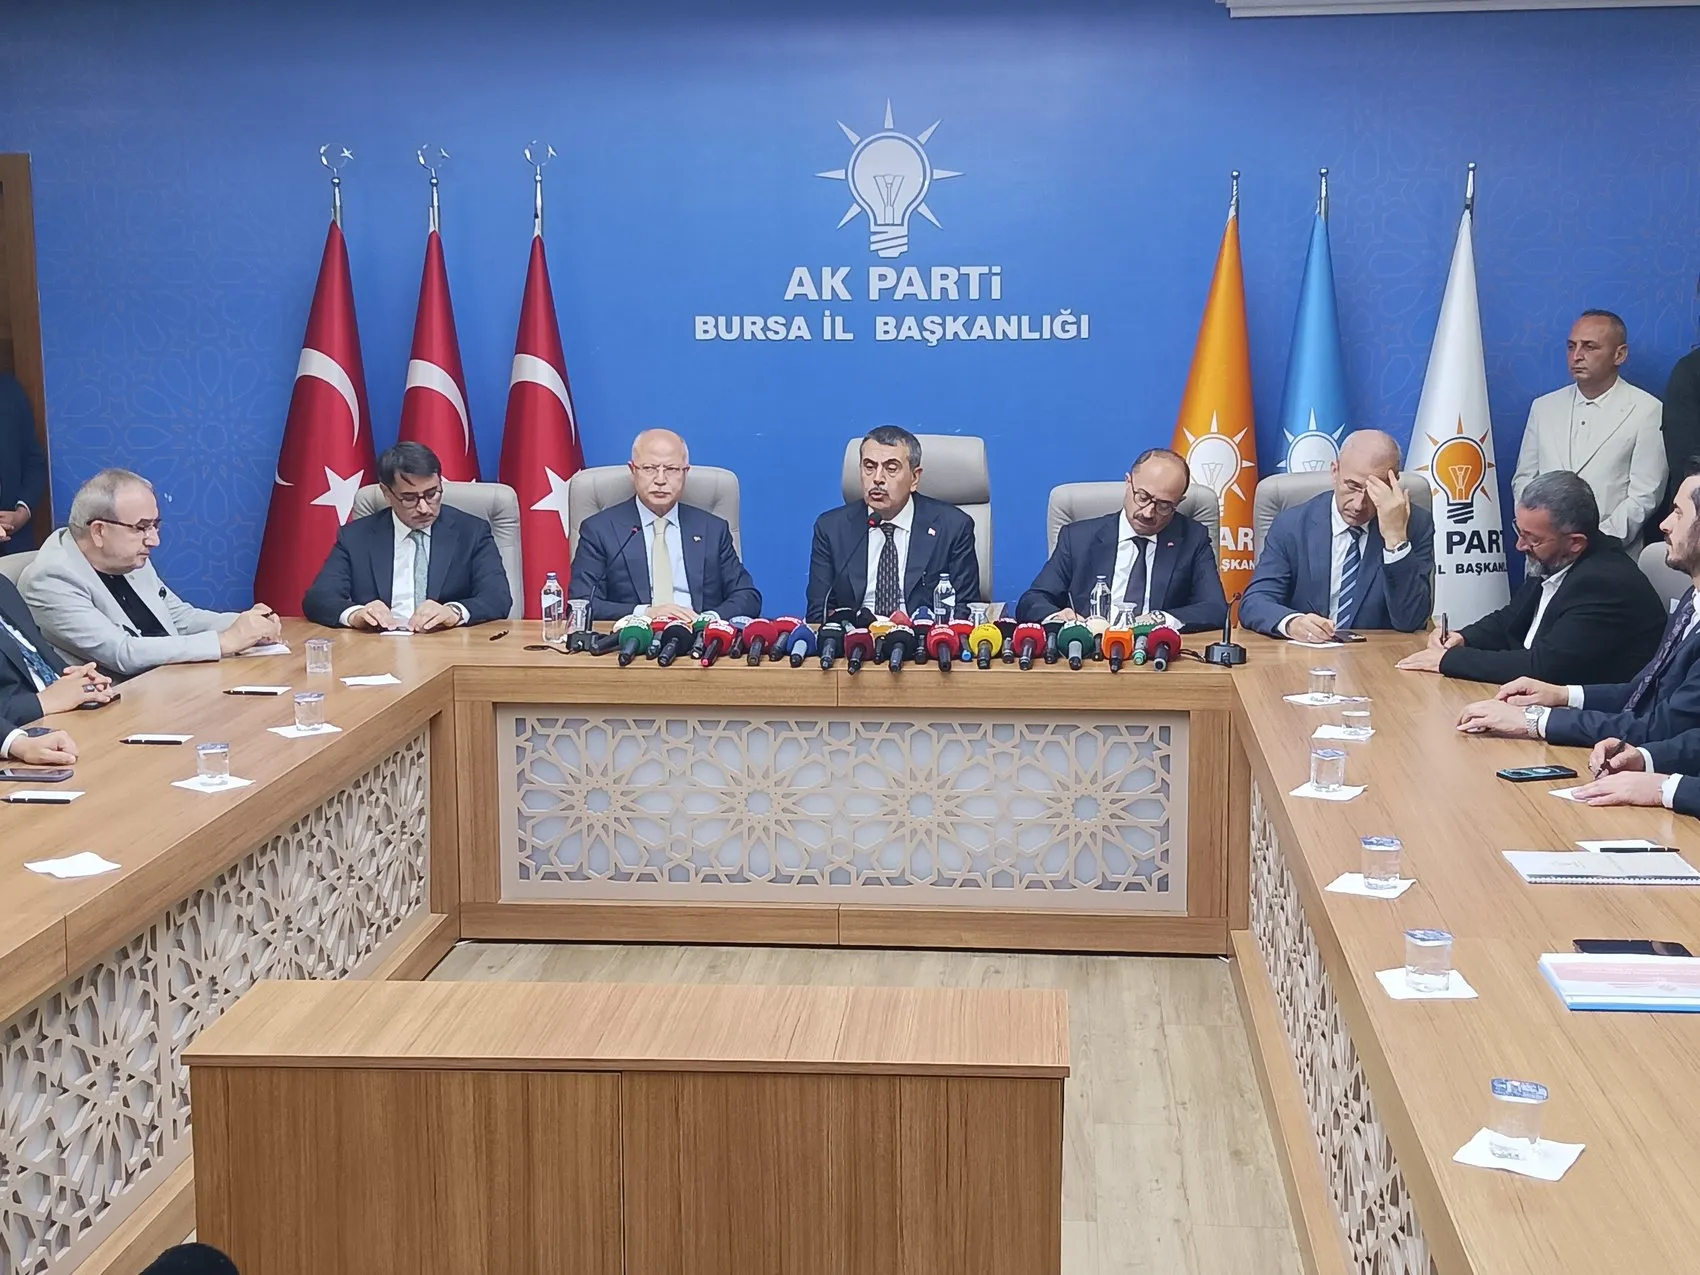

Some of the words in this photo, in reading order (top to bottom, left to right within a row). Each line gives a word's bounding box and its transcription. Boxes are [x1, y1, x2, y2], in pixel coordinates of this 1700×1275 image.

[783, 266, 852, 300] AK
[695, 315, 812, 340] BURSA
[823, 310, 854, 340] İL
[875, 308, 1090, 346] BAŞKANLIĞI
[1446, 530, 1503, 555] PAR
